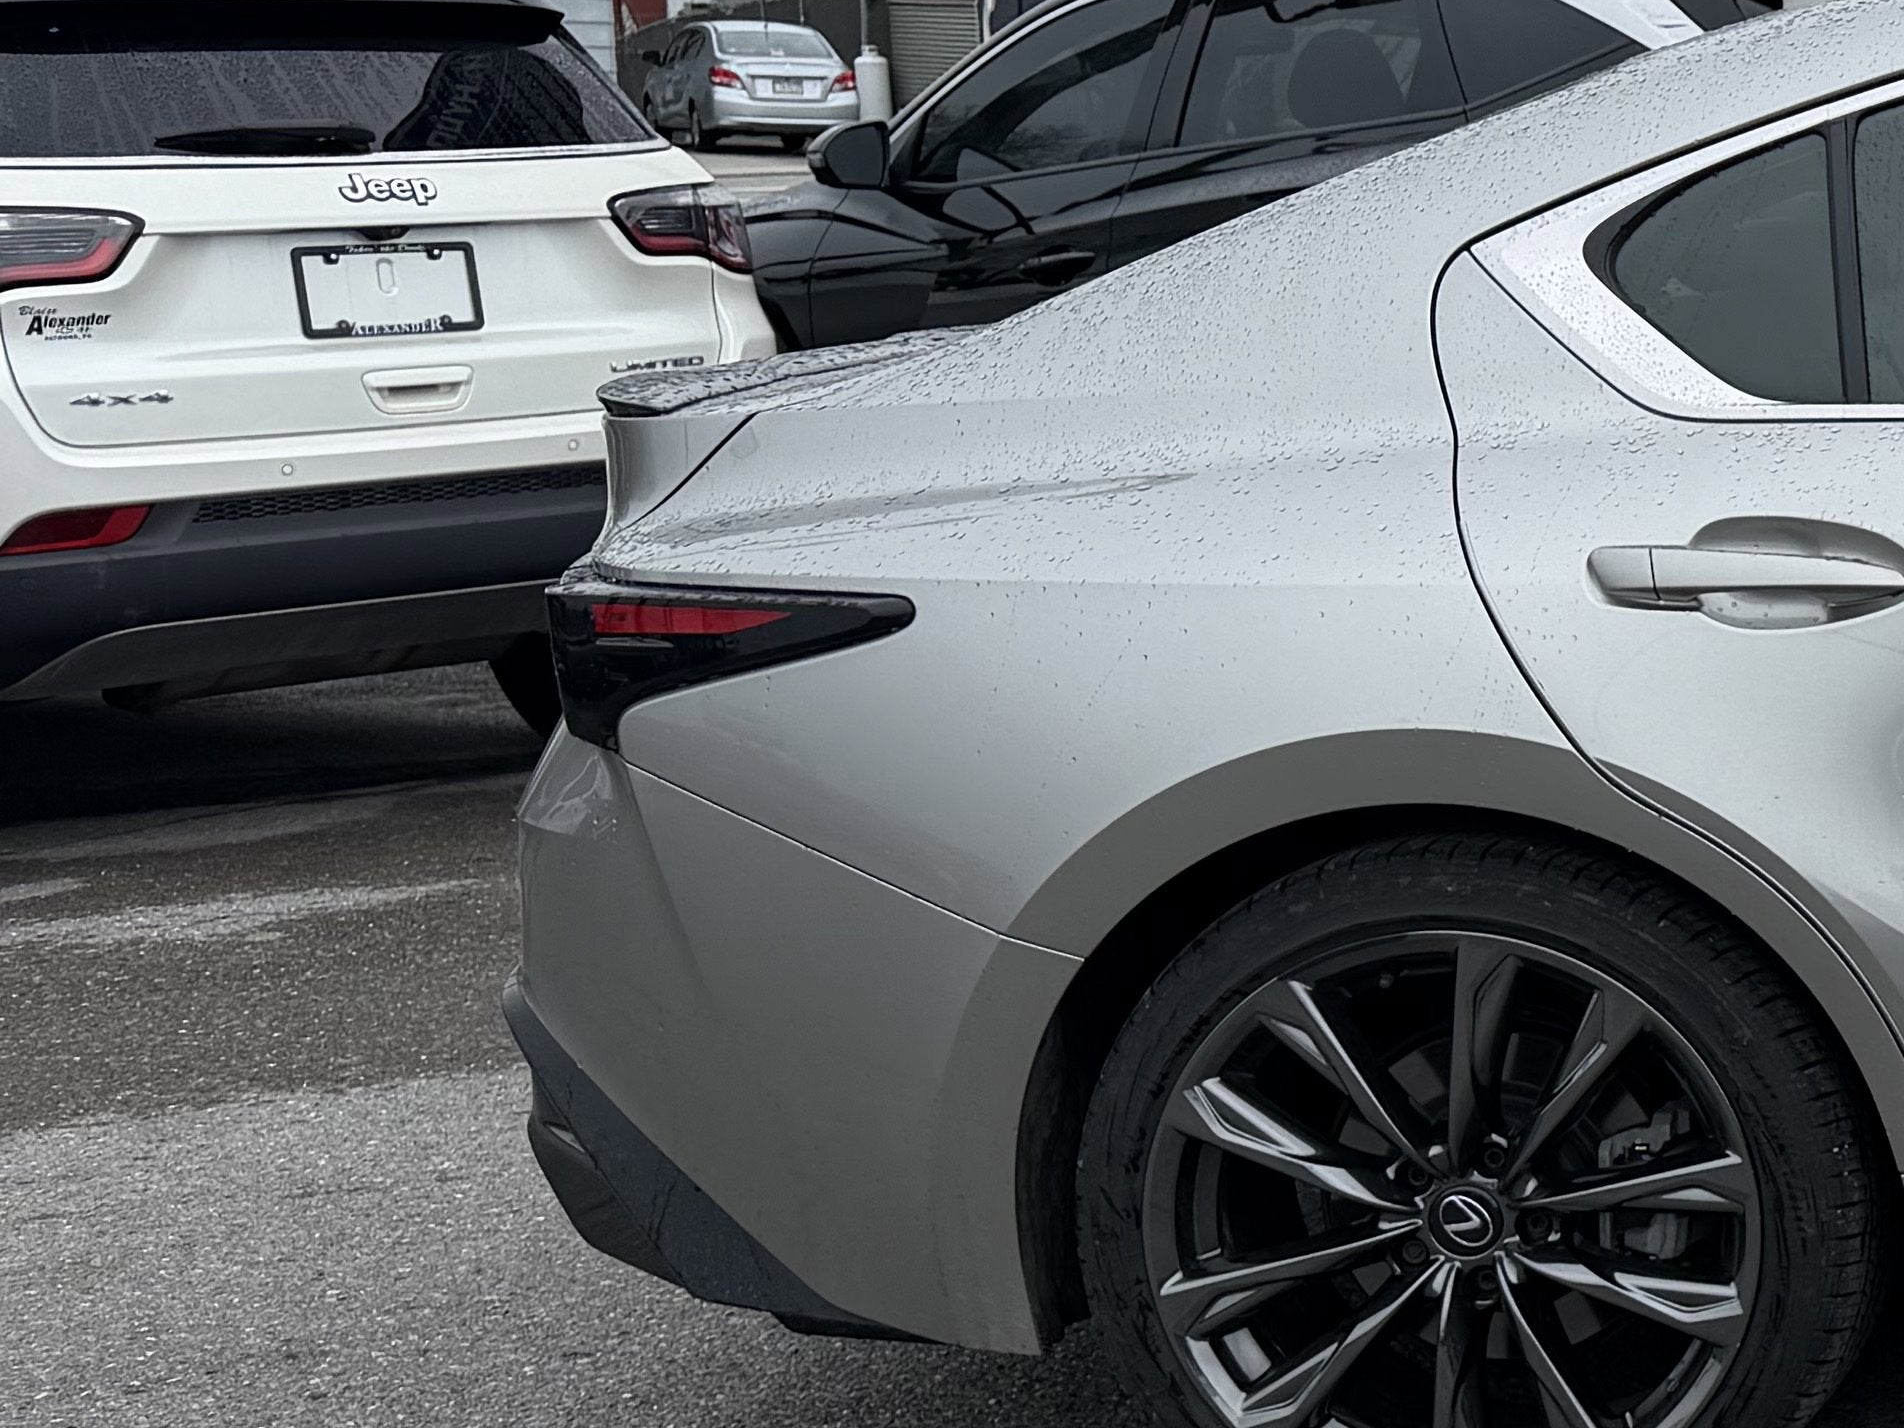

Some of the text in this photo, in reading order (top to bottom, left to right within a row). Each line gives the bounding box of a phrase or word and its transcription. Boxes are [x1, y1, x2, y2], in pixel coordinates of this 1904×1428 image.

[338, 173, 438, 206] Jeep
[25, 312, 112, 335] Alexander
[351, 318, 444, 337] ALEXANDER
[609, 355, 705, 373] LIMITED
